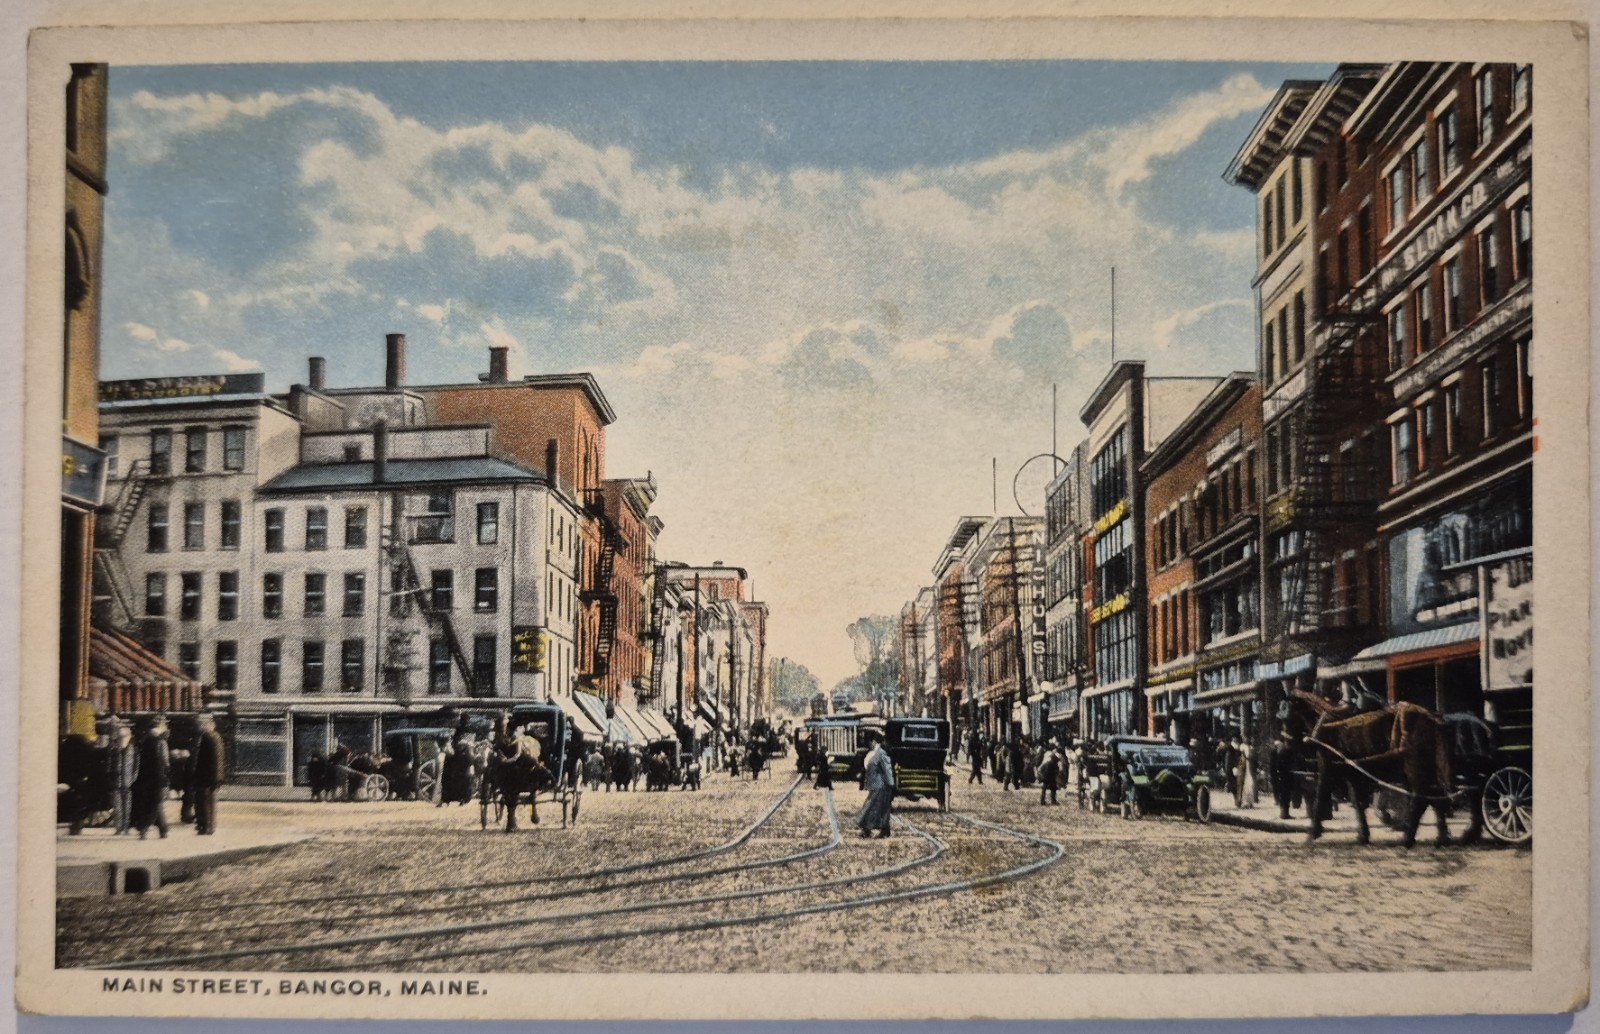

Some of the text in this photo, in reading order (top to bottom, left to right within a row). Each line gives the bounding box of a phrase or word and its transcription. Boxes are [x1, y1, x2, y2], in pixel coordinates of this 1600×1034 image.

[102, 977, 489, 997] MAIN STREET, BANGOR, MAINE.
